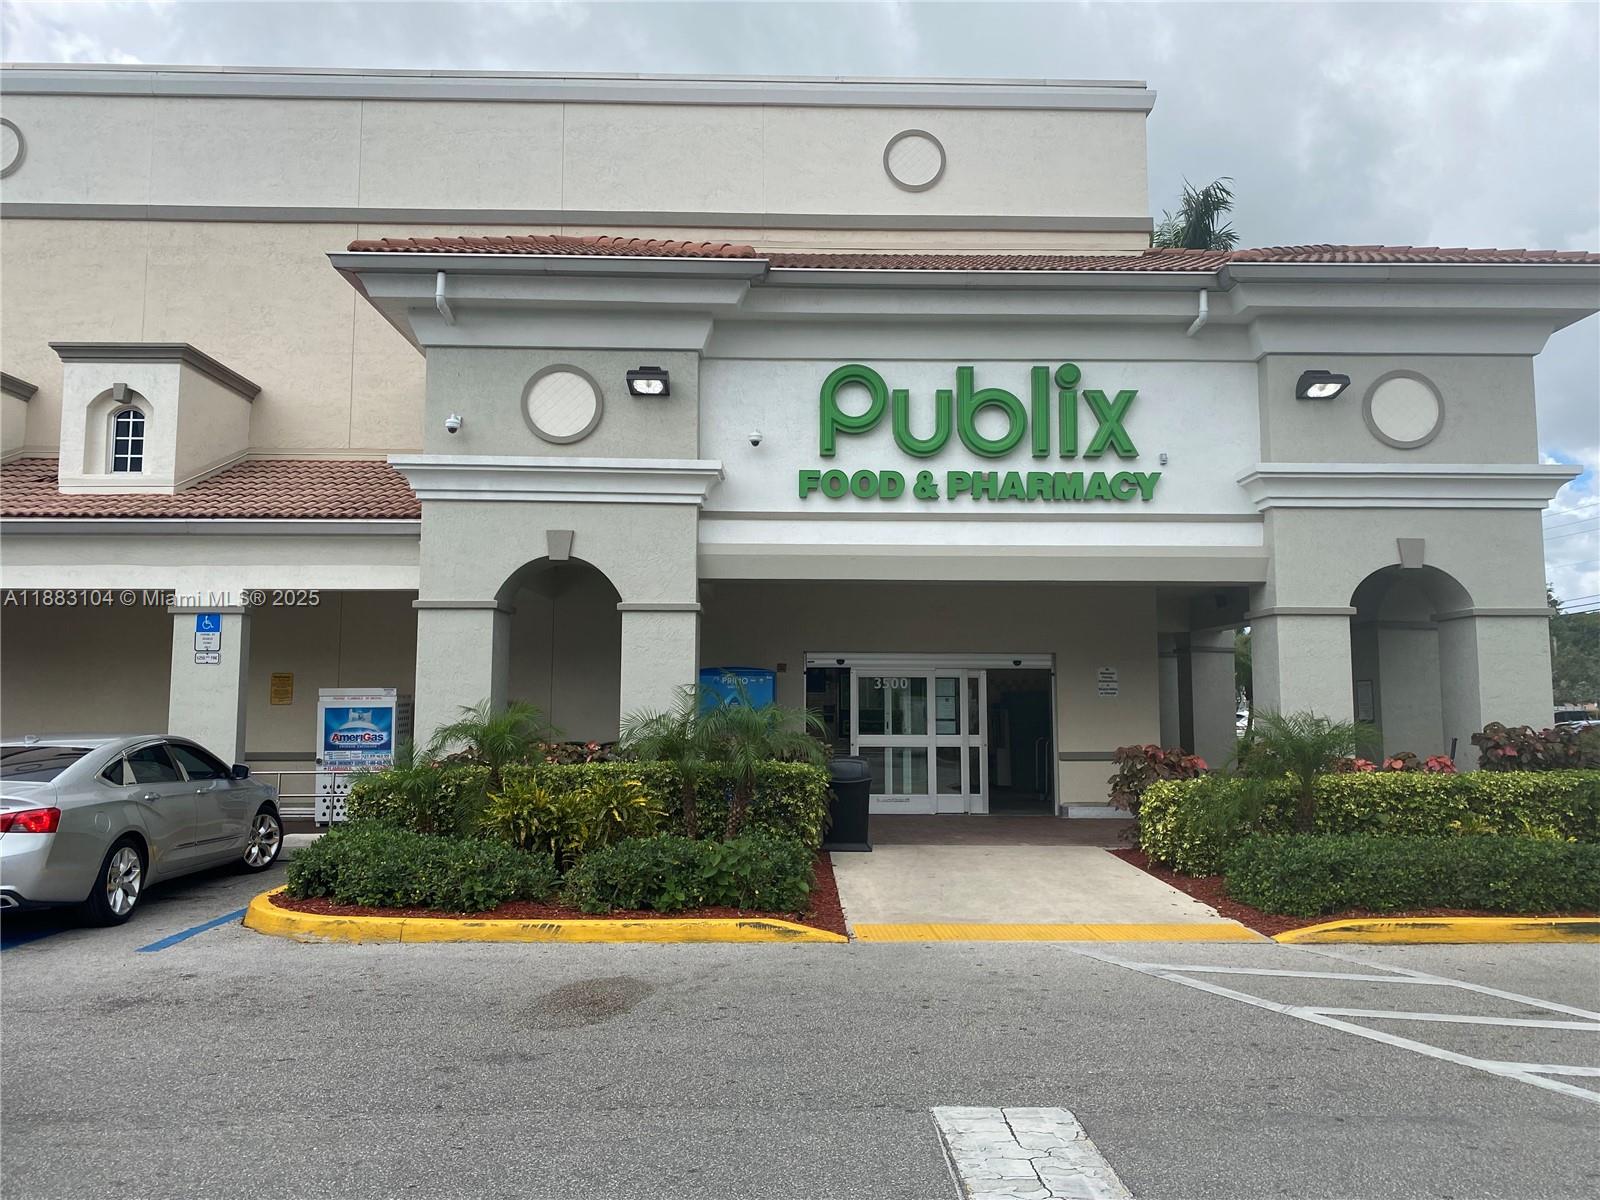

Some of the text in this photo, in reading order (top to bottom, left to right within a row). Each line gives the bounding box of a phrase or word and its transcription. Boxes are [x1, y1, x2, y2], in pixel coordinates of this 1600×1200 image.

[819, 362, 1139, 459] Publix
[798, 469, 1161, 502] FOOD & PHARMACY
[874, 678, 908, 689] 3500
[331, 732, 384, 742] AmeriGas
